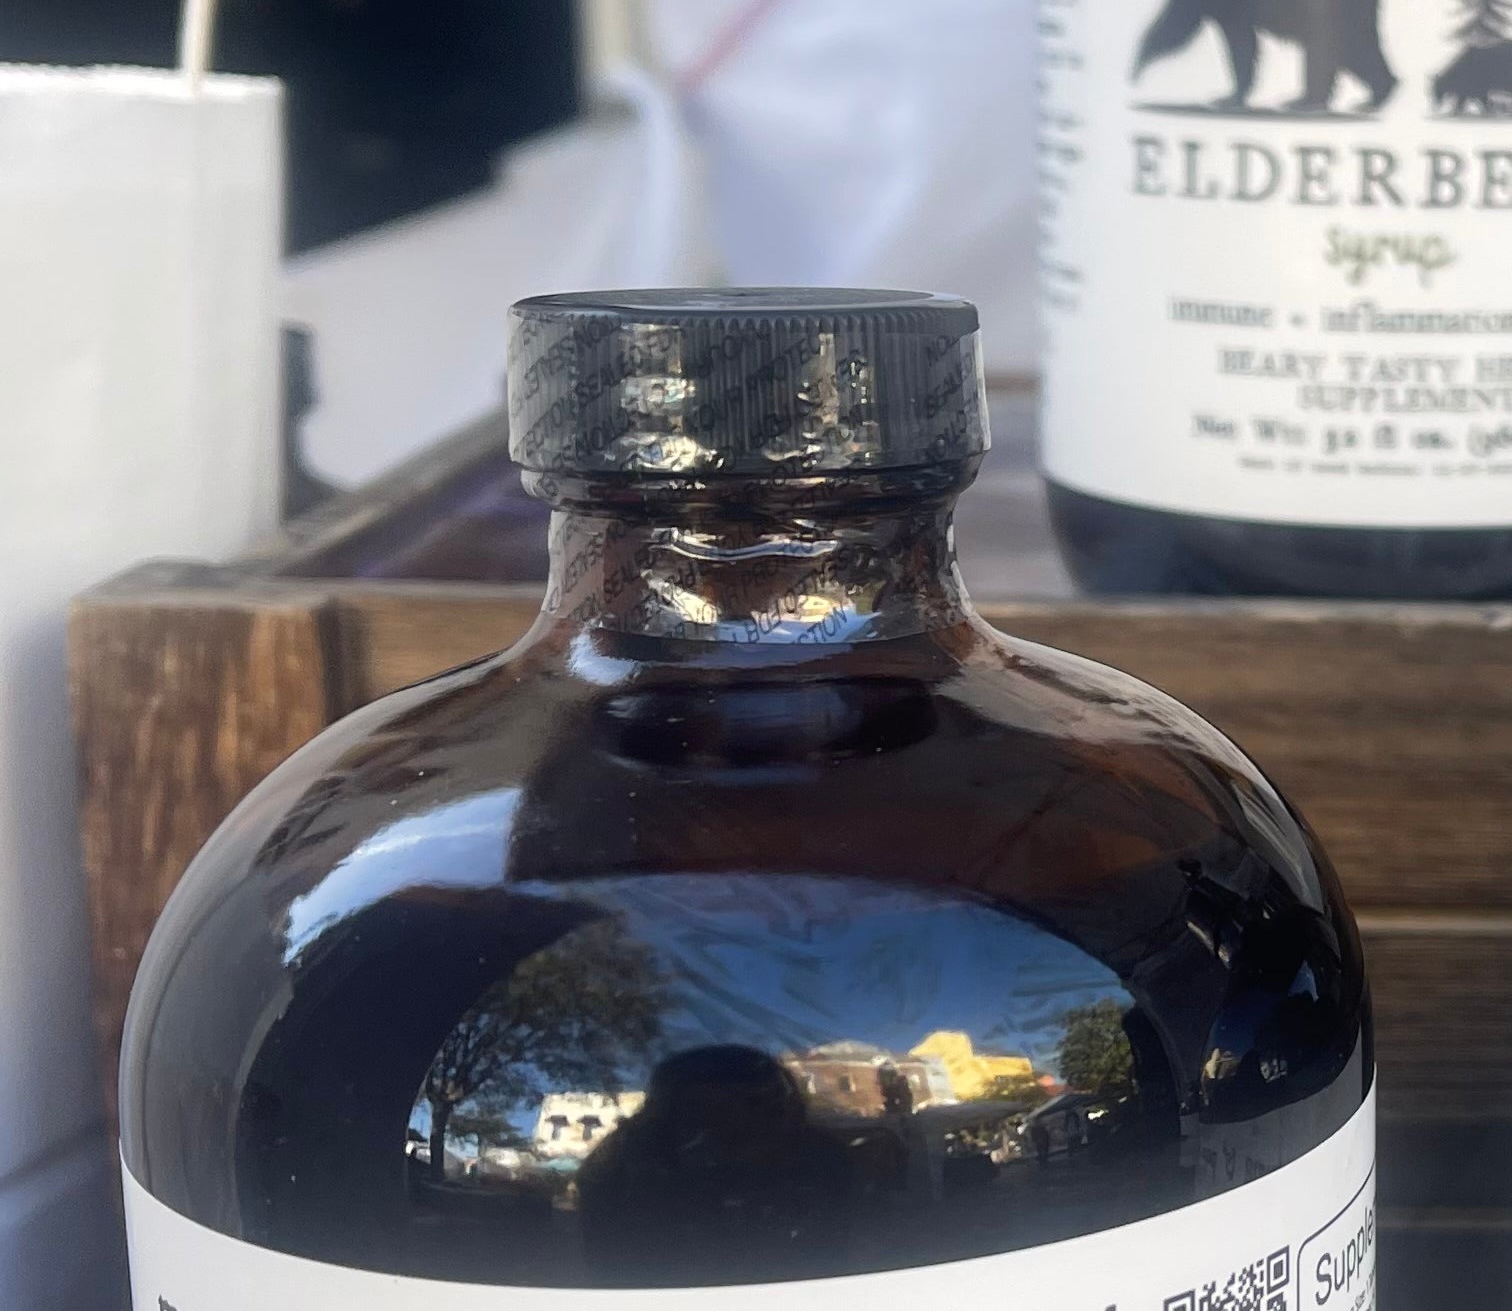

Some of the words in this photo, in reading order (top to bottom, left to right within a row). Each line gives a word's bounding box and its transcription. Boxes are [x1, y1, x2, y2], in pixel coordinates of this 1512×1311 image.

[1324, 227, 1455, 285] syrup
[1217, 348, 1326, 378] BEARY
[1341, 351, 1462, 382] TASTY
[1314, 1200, 1374, 1307] Supple
